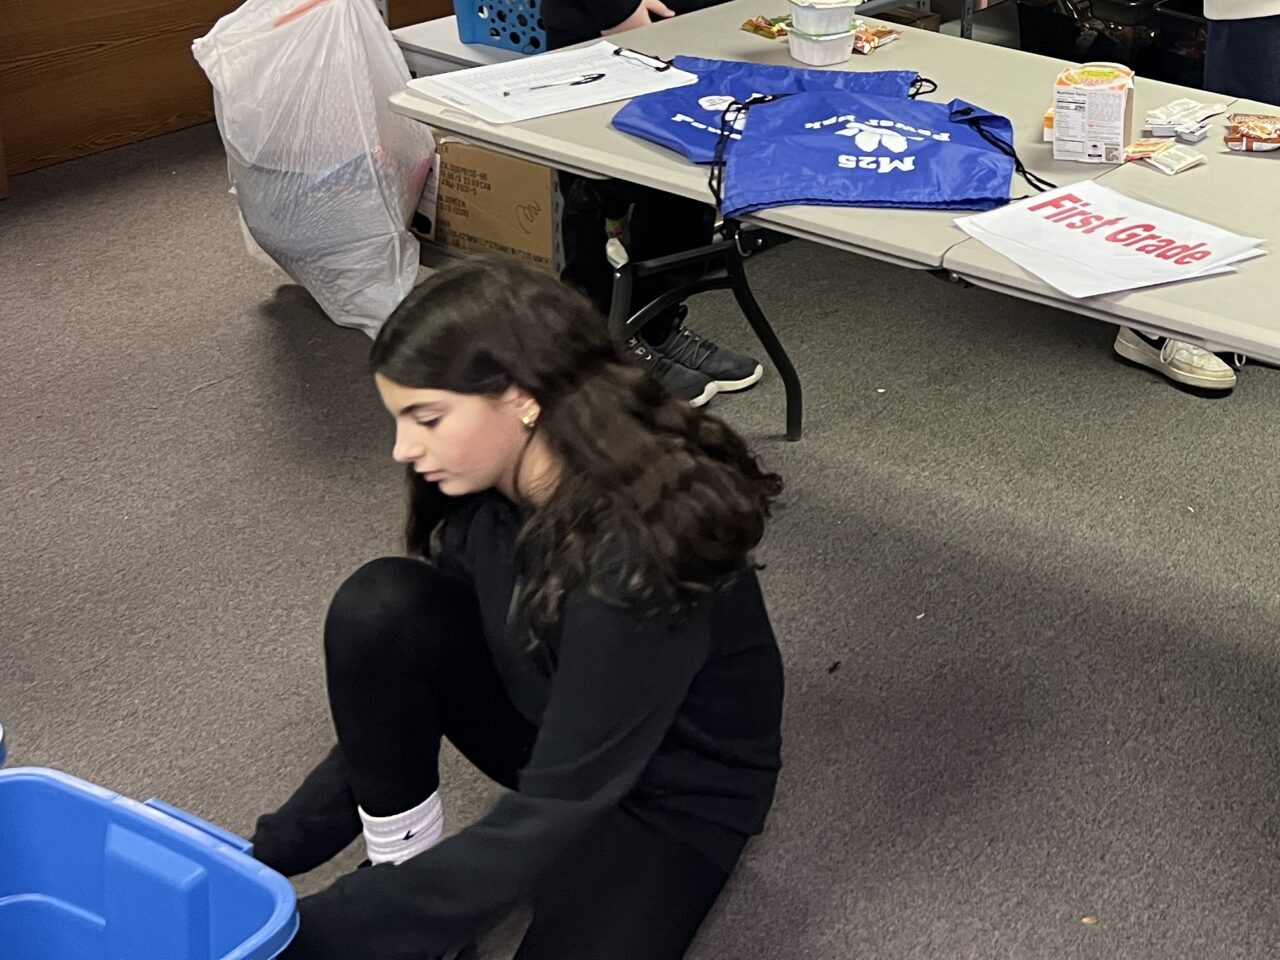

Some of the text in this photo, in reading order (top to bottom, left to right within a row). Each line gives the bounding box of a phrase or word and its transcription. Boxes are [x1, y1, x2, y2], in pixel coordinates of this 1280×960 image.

[838, 154, 916, 174] M25
[1027, 193, 1212, 266] First Grade
